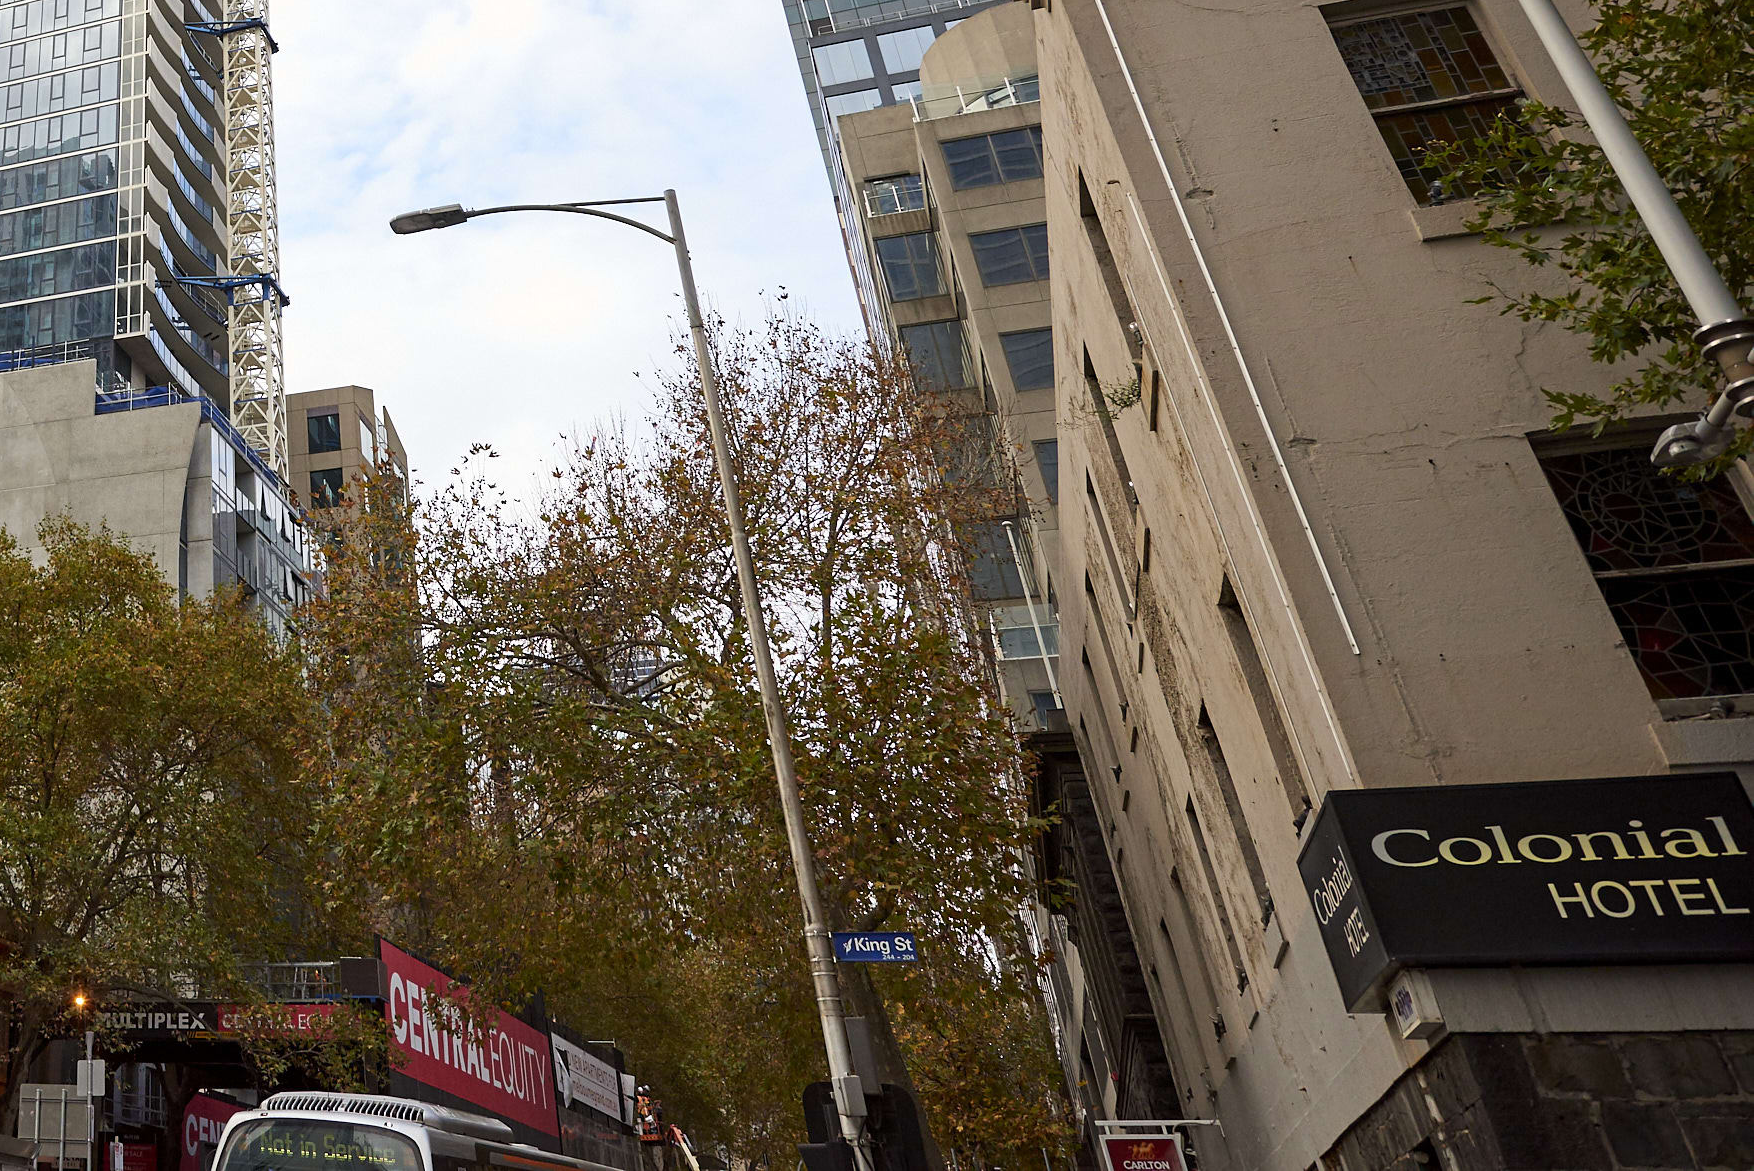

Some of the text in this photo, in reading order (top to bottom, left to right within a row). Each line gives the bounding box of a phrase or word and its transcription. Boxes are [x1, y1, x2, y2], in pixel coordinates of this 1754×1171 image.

[1371, 815, 1748, 867] Colonial
[1313, 845, 1353, 925] Colonial
[1547, 877, 1751, 919] HOTEL
[854, 936, 913, 954] King St
[1343, 906, 1370, 958] HOTEL
[489, 1027, 547, 1110] EQUITY
[260, 1133, 396, 1164] Not in Service
[1123, 1160, 1170, 1170] CARLTON
